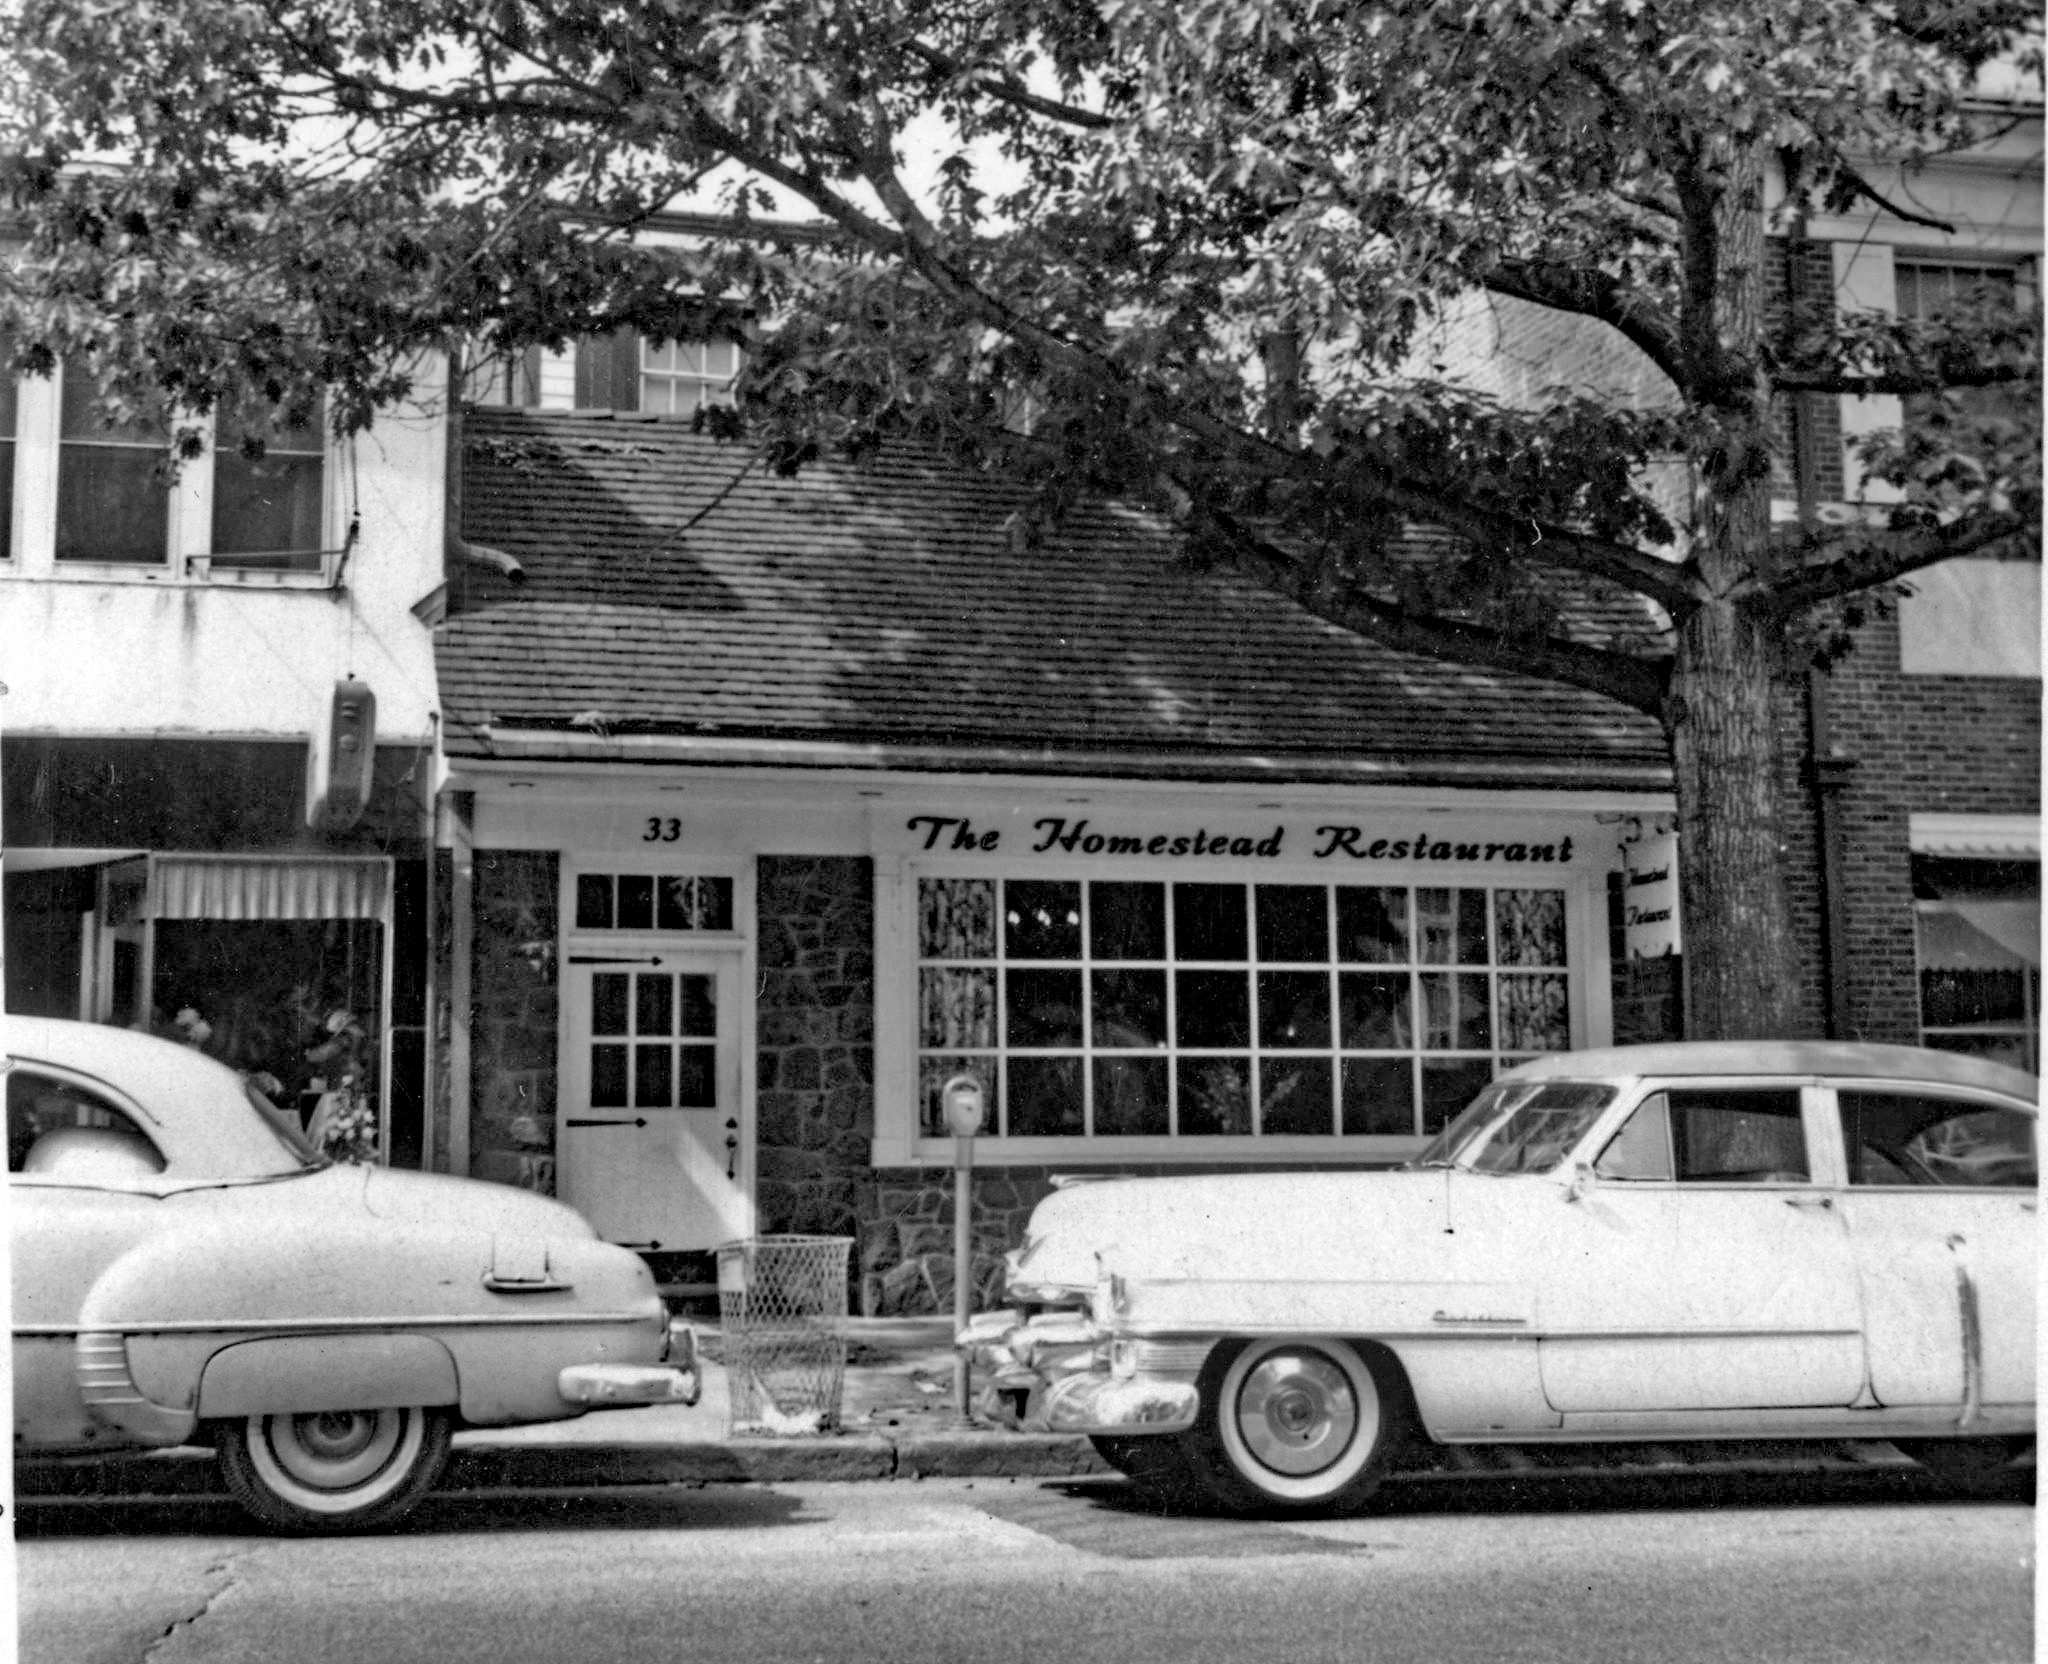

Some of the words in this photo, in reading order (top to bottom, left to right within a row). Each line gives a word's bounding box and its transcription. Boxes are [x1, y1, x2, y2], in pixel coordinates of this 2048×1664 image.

[642, 816, 682, 842] 33
[905, 814, 1001, 853] The
[1031, 817, 1286, 858] Homestead
[1312, 824, 1575, 864] Restaurant
